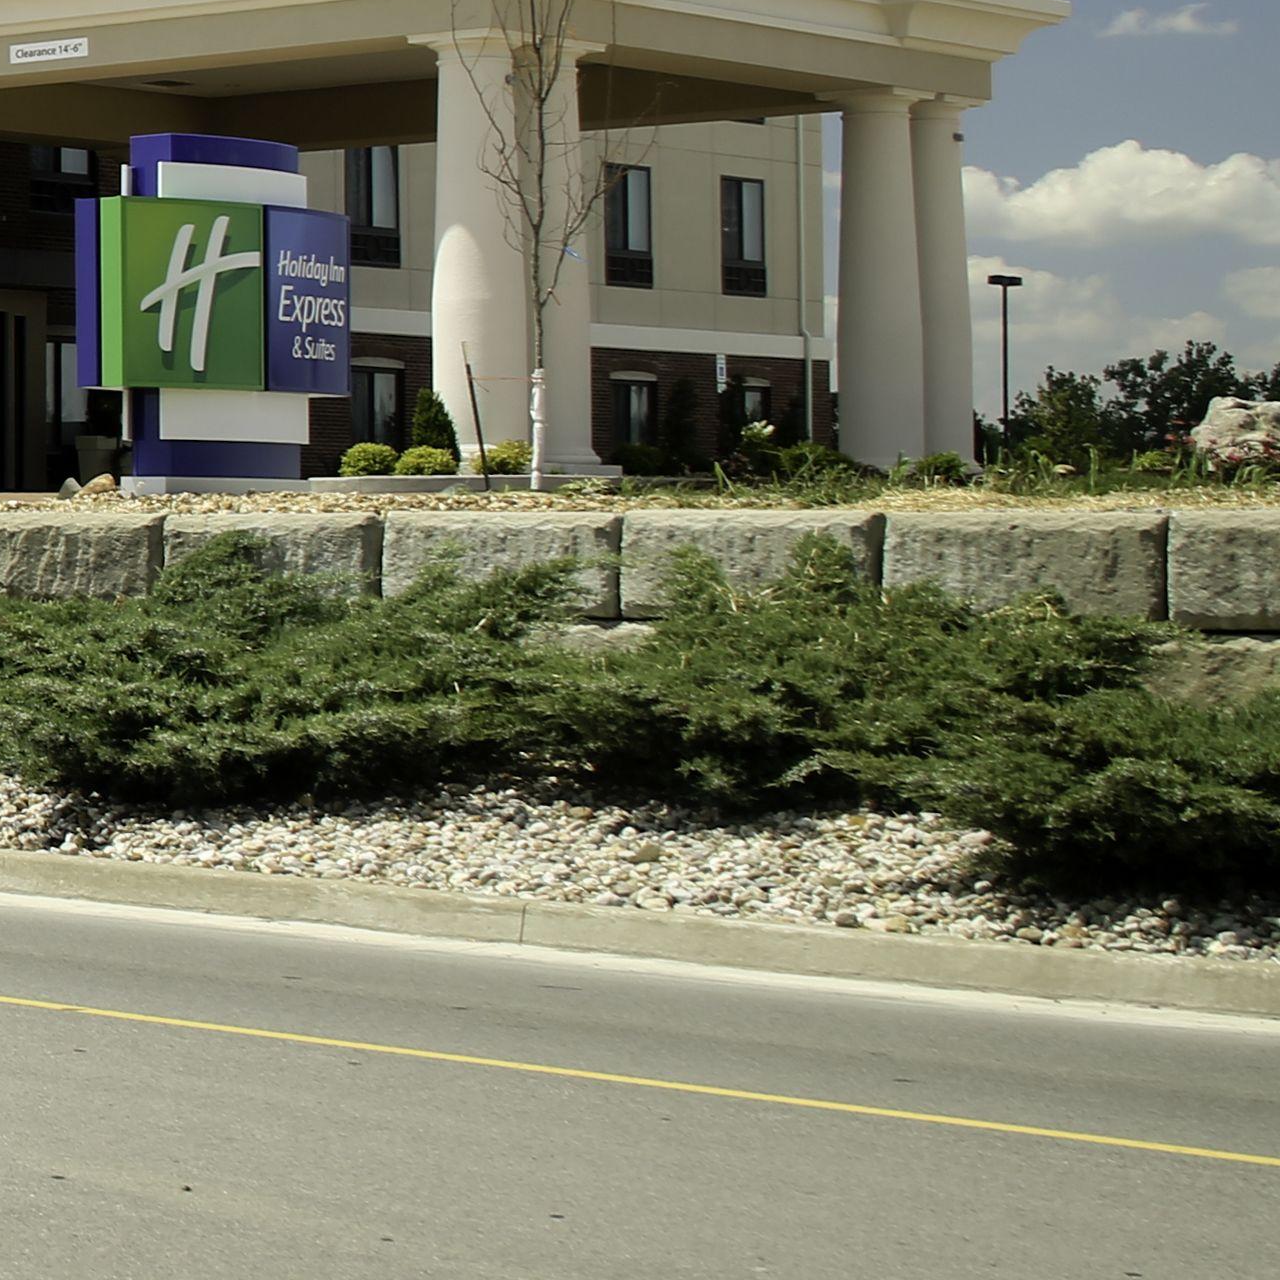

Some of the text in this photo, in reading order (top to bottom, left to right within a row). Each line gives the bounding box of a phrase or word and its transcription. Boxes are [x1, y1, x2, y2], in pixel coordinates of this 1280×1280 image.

[15, 47, 57, 59] Clearance
[277, 250, 345, 287] Holiday Inn
[278, 285, 346, 333] Express
[292, 335, 336, 361] & Suites
